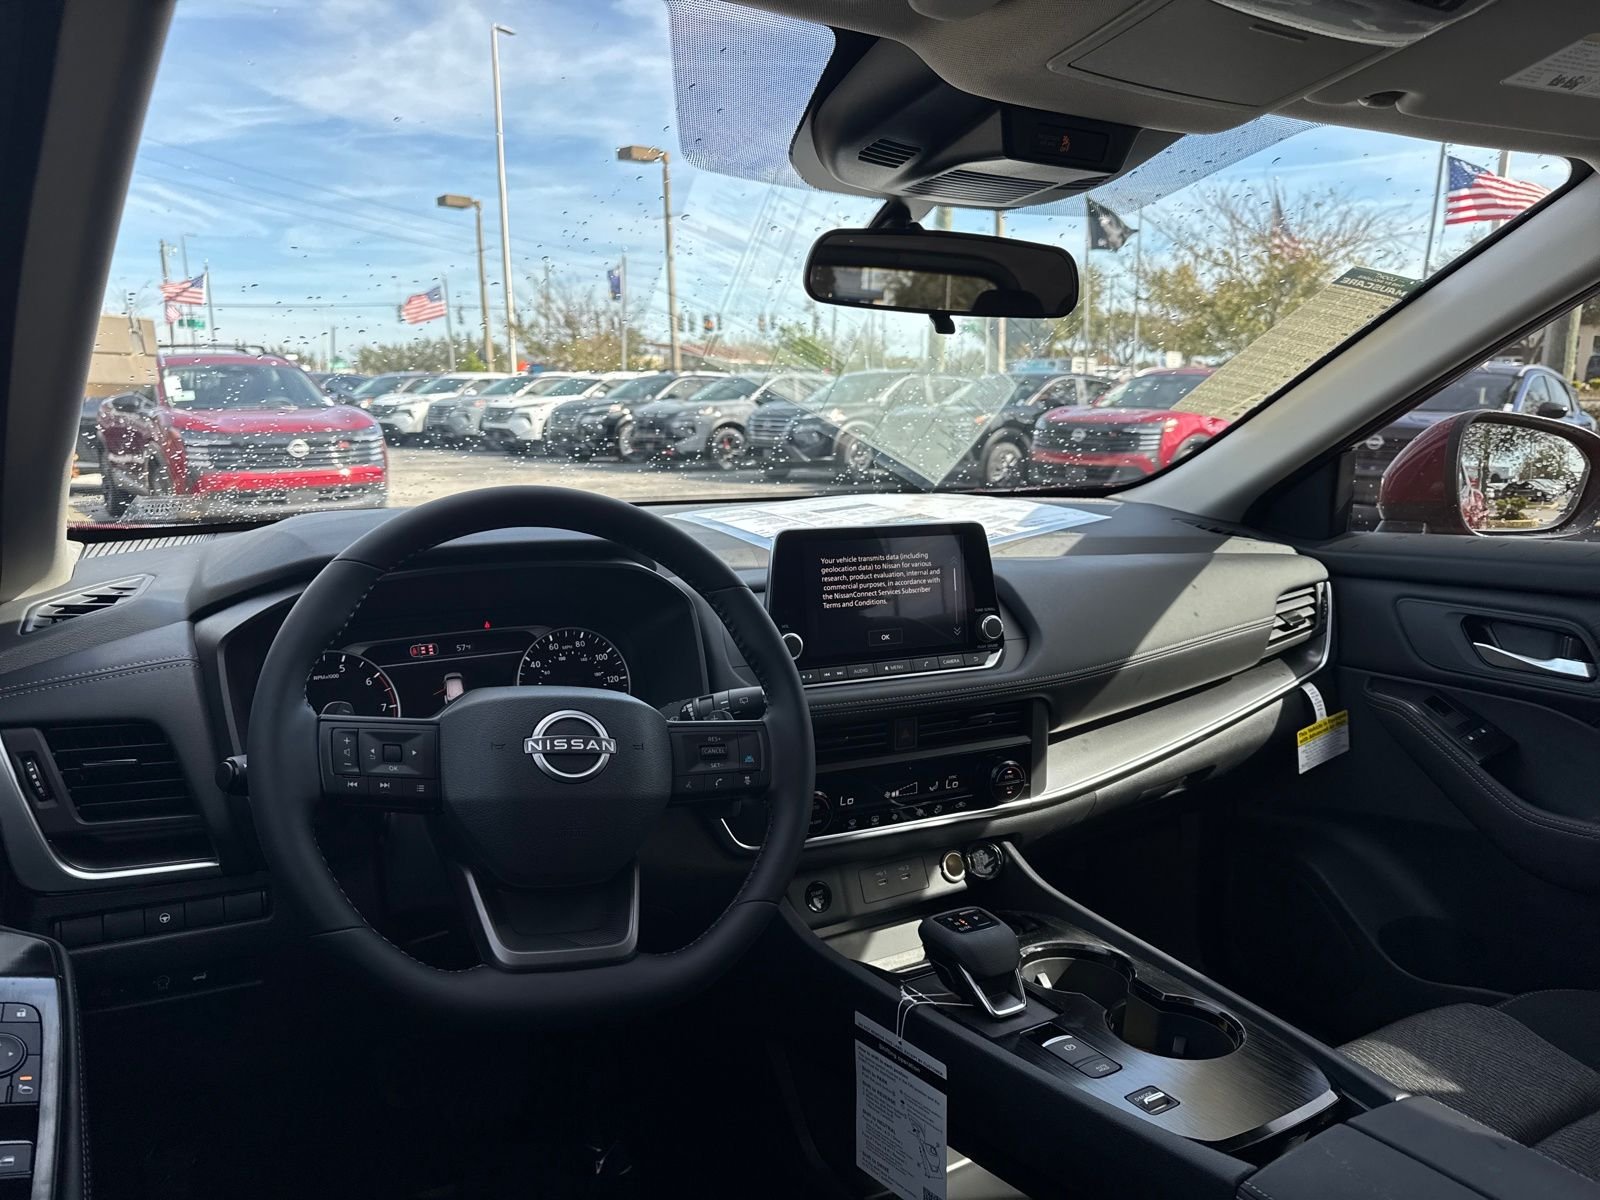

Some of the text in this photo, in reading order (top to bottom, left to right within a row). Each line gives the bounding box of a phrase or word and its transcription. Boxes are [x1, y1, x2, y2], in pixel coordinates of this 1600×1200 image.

[858, 554, 885, 562] transmits
[900, 552, 928, 560] (including
[821, 565, 857, 575] geolocation
[858, 563, 873, 571] data)
[822, 574, 848, 582] research,
[849, 573, 873, 581] product
[873, 571, 905, 579] evaluation,
[823, 583, 859, 591] commercial
[859, 581, 887, 590] purposes,
[895, 578, 926, 586] accordance
[834, 591, 877, 599] NissanConnect
[878, 588, 901, 596] Services
[901, 586, 931, 594] Subscriber
[854, 599, 887, 607] Conditions.
[881, 633, 890, 641] OK
[595, 653, 608, 661] 100
[339, 664, 346, 673] 5
[366, 678, 372, 686] 6
[607, 675, 619, 683] 120
[381, 704, 387, 712] 7
[527, 739, 614, 752] NISSAN
